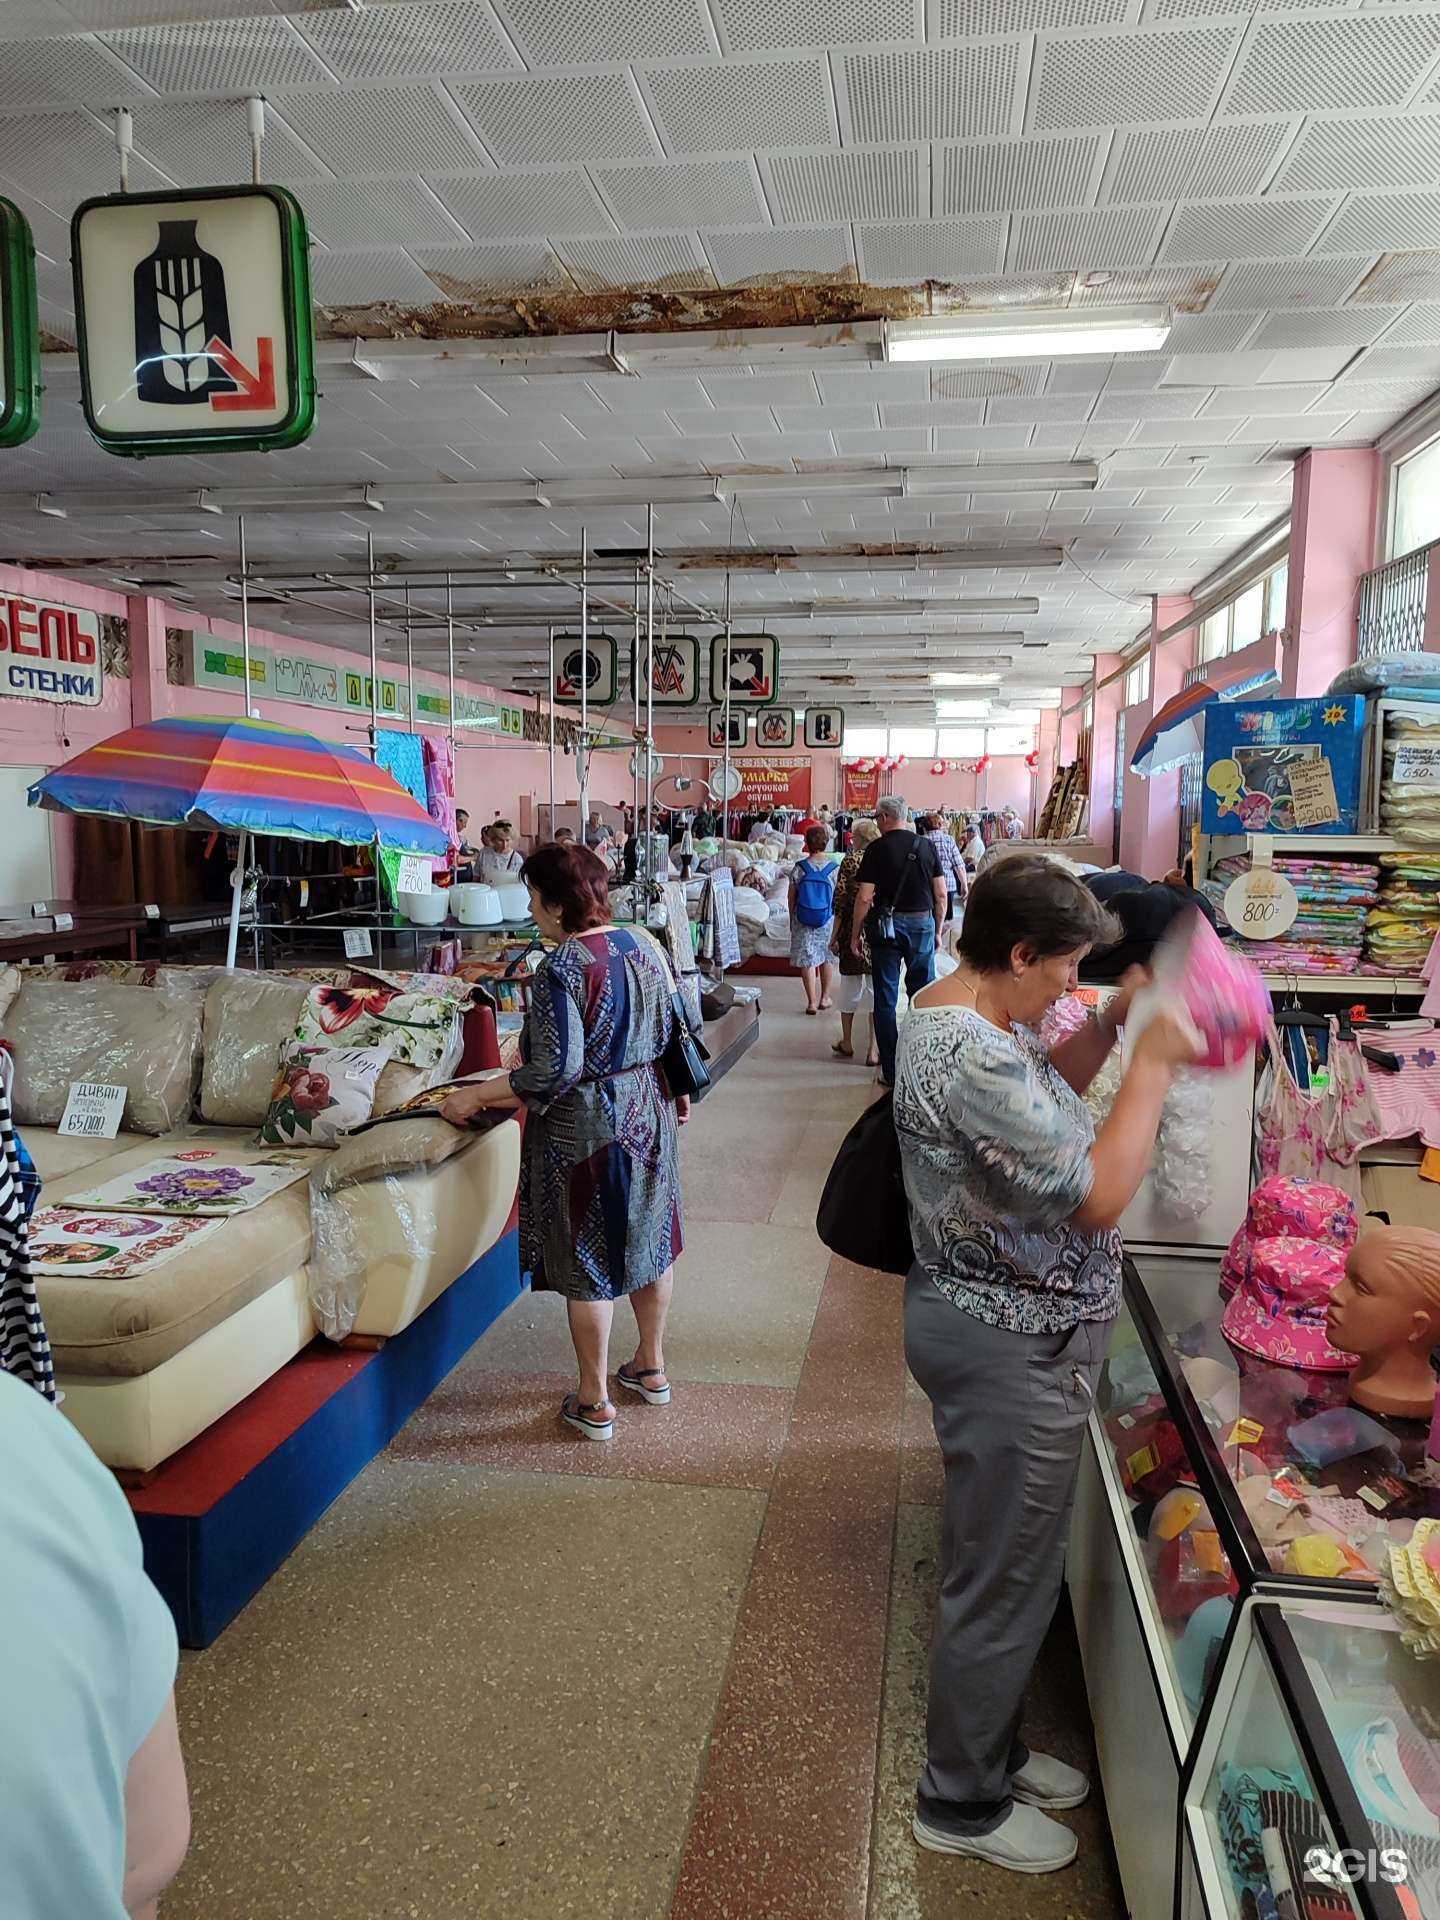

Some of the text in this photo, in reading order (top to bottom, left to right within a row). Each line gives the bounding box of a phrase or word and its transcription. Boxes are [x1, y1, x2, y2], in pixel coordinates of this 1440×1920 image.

[9, 665, 94, 697] СТЕНКИ
[275, 657, 313, 681] КРУПА
[78, 1085, 119, 1100] ДИВАН
